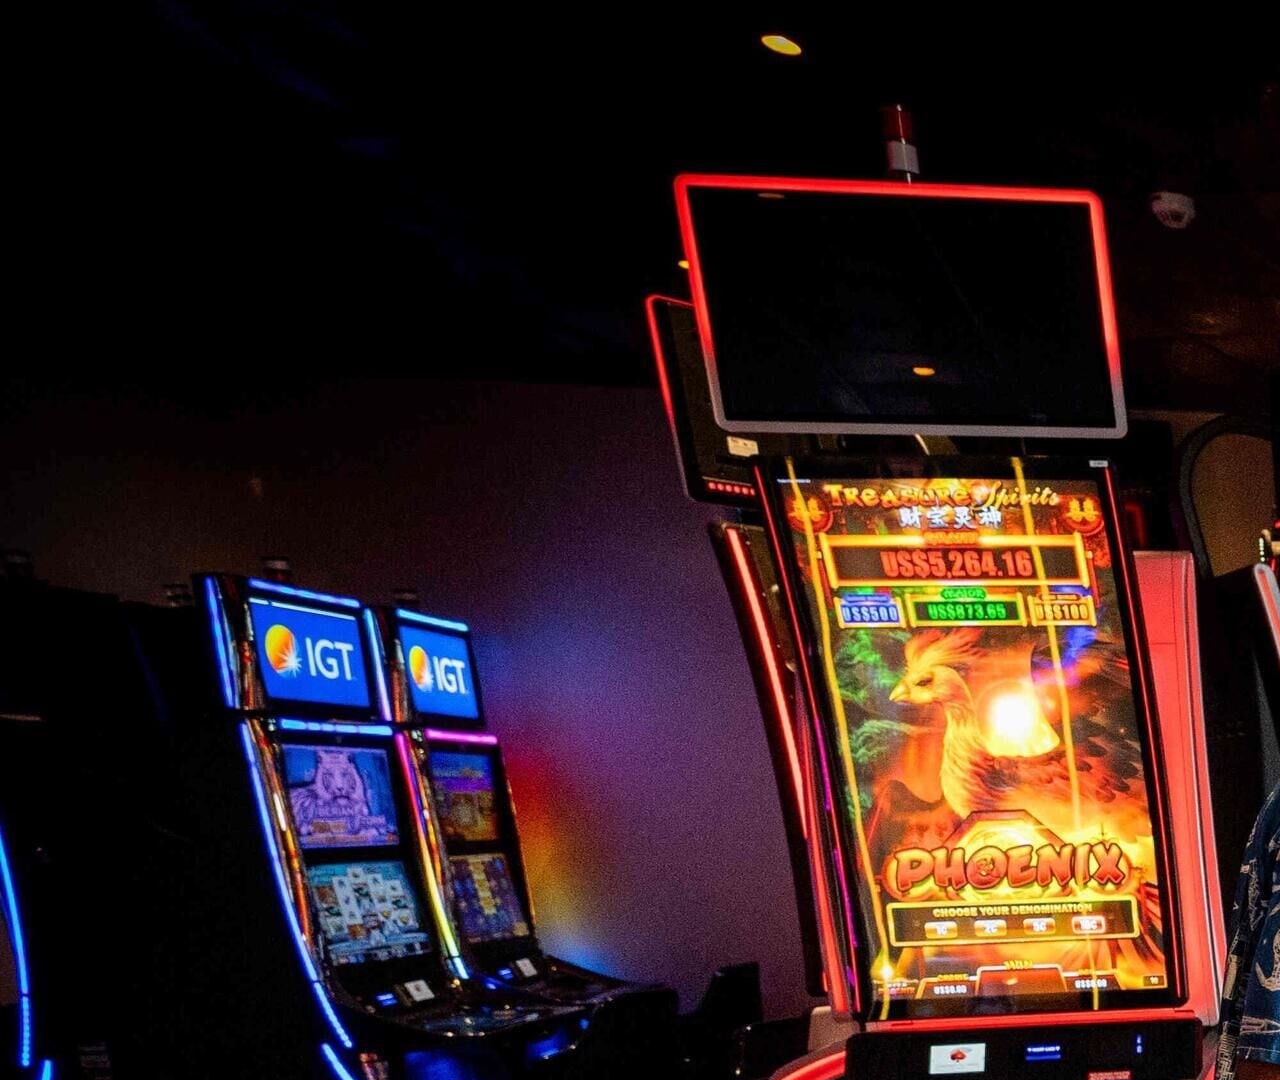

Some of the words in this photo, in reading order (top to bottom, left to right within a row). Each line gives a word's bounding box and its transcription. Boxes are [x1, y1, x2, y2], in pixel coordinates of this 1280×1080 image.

[823, 484, 970, 507] TREASURE
[880, 549, 1033, 579] US$5,264.16
[305, 636, 354, 681] IGT
[433, 655, 466, 694] IGT
[894, 843, 1126, 892] PHOENIX
[932, 907, 978, 918] CHOOSE
[979, 905, 1010, 916] YOUR
[1011, 902, 1093, 915] DENOMINATION
